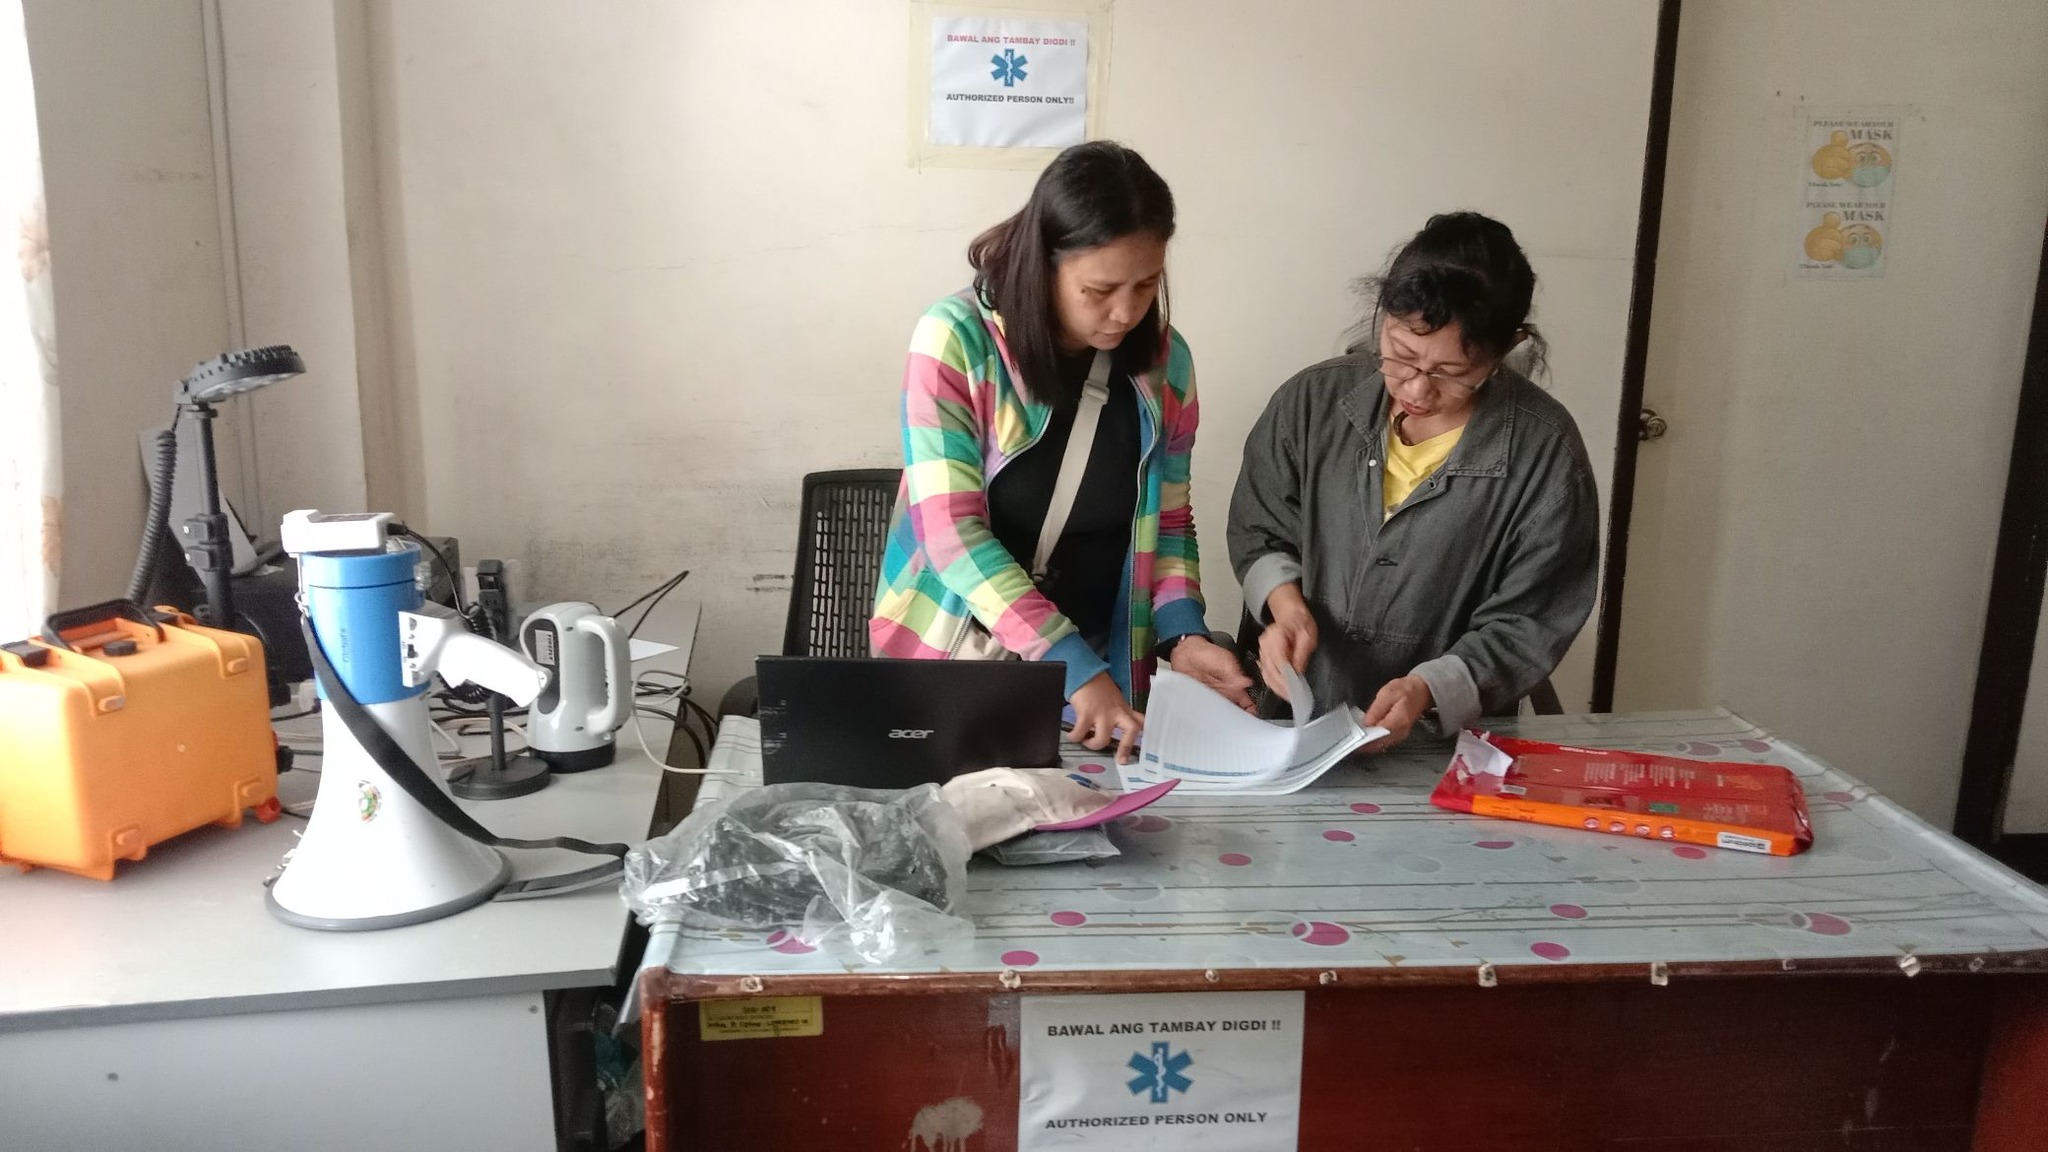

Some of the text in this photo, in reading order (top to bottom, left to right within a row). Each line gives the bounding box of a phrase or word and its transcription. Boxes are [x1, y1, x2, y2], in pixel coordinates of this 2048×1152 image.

[946, 34, 979, 43] BAWAL
[981, 36, 1000, 44] ANG
[1003, 36, 1040, 45] TAMBAY
[1043, 38, 1068, 46] DIGDI
[946, 93, 1004, 102] AUTHORIZED
[1007, 95, 1043, 104] PERSON
[1850, 129, 1893, 140] MASK
[1843, 210, 1885, 221] MASK
[888, 728, 934, 739] acer
[1047, 1020, 1282, 1036] BAWAL ANG TAMBAY DIGDI !!
[1045, 1111, 1268, 1129] AUTHORIZED PERSON ONLY
